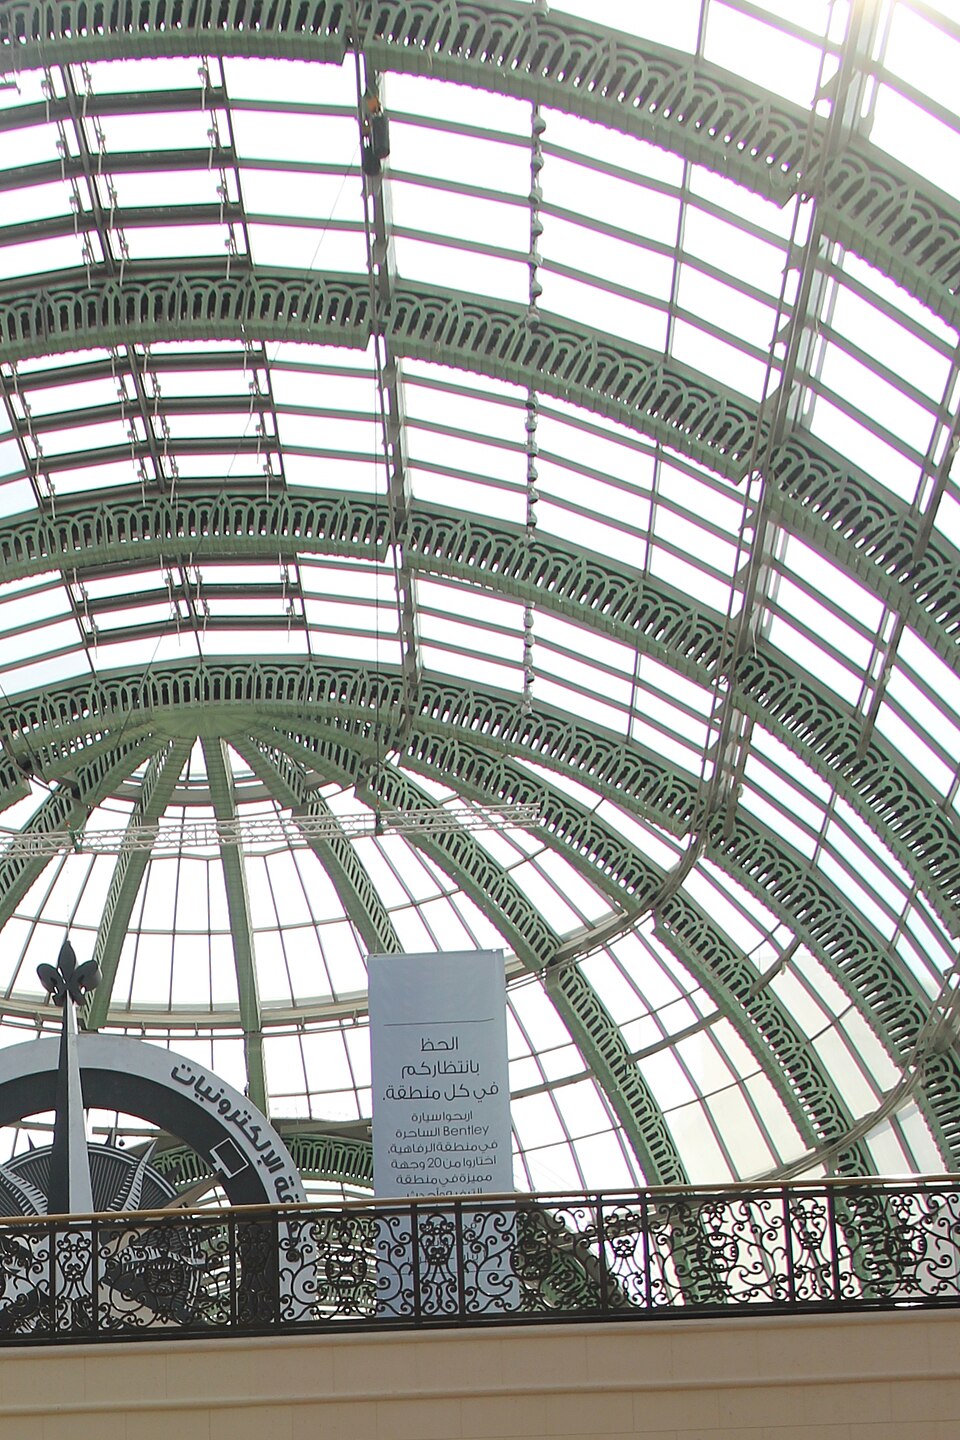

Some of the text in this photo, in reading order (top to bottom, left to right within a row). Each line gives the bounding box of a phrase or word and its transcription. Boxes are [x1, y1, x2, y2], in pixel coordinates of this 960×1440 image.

[420, 1036, 458, 1052] الحظ
[401, 1059, 480, 1080] بانتظاركم
[382, 1081, 499, 1103] في كل منطقة.
[170, 1063, 285, 1174] الإلكترونيات
[443, 1125, 490, 1137] Bentley
[427, 1157, 442, 1169] 20
